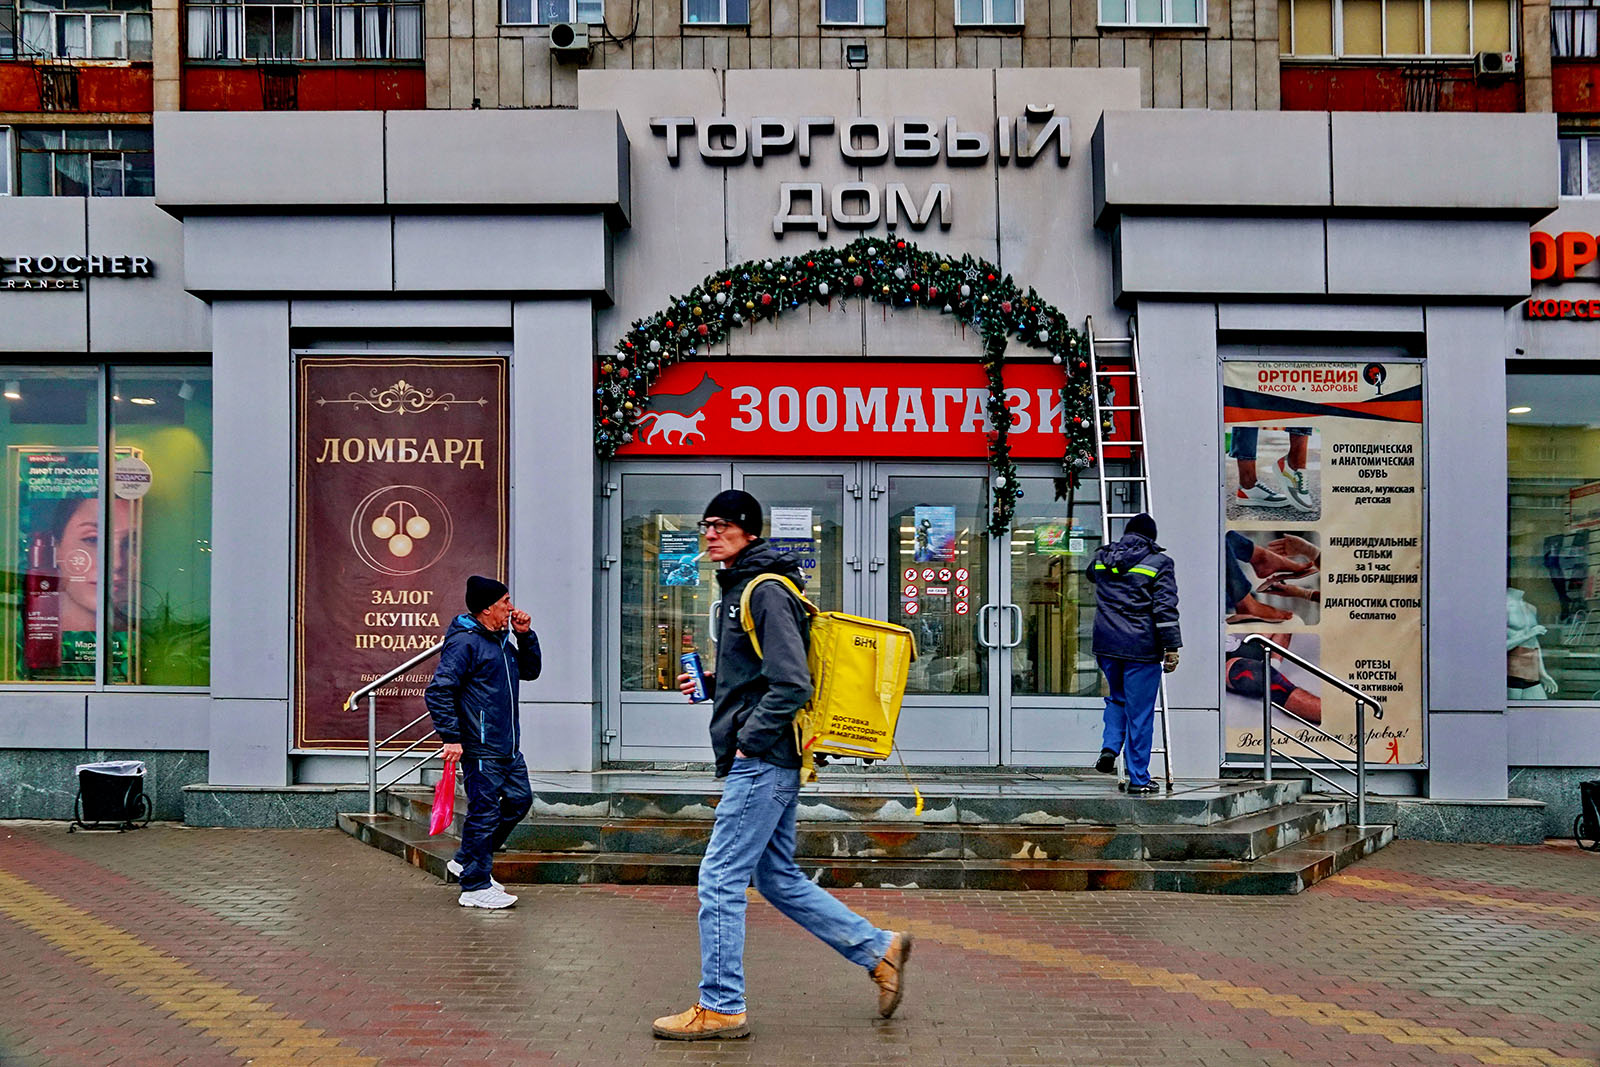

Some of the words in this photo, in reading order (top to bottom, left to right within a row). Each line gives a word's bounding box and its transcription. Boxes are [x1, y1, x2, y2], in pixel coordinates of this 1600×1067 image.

[650, 104, 1070, 165] ТОРГОВЫЙ
[774, 182, 952, 238] ДОМ
[1530, 231, 1600, 280] ОР
[16, 255, 149, 273] ROCHER
[1258, 370, 1358, 384] ОРТОПЕДИЯ
[1258, 384, 1297, 393] КРАСОТА
[1311, 384, 1358, 393] ЗДОРОВЬЕ
[730, 386, 1116, 434] ЗООМАГАЗИ
[316, 438, 485, 470] ЛОМБАРД
[1333, 444, 1413, 455] ОРТОПЕДИЧЕСКАЯ
[1331, 458, 1337, 466] и
[1339, 456, 1415, 466] АНАТОМИЧЕСКАЯ
[1358, 469, 1388, 479] ОБУВЬ
[1332, 486, 1373, 494] женская,
[1375, 486, 1415, 495] мужская
[1355, 496, 1391, 505] детская
[1329, 537, 1418, 548] ИНДИВИДУАЛЬНЫЕ
[1354, 550, 1393, 559] СТЕЛЬКИ
[1368, 563, 1373, 571] 1
[1328, 574, 1334, 583] В
[1336, 574, 1360, 584] ДЕНЬ
[1362, 574, 1418, 585] ОБРАЩЕНИЯ
[371, 590, 433, 605] ЗАЛОГ
[1325, 598, 1388, 608] ДИАГНОСТИКА
[1390, 599, 1421, 608] СТОПЫ
[364, 612, 440, 627] СКУПКА
[1349, 611, 1397, 621] бесплатно
[1355, 660, 1391, 669] ОРТЕЗЫ
[1357, 671, 1397, 680] КОРСЕТЫ
[1361, 683, 1403, 692] активной
[833, 715, 869, 726] доставка
